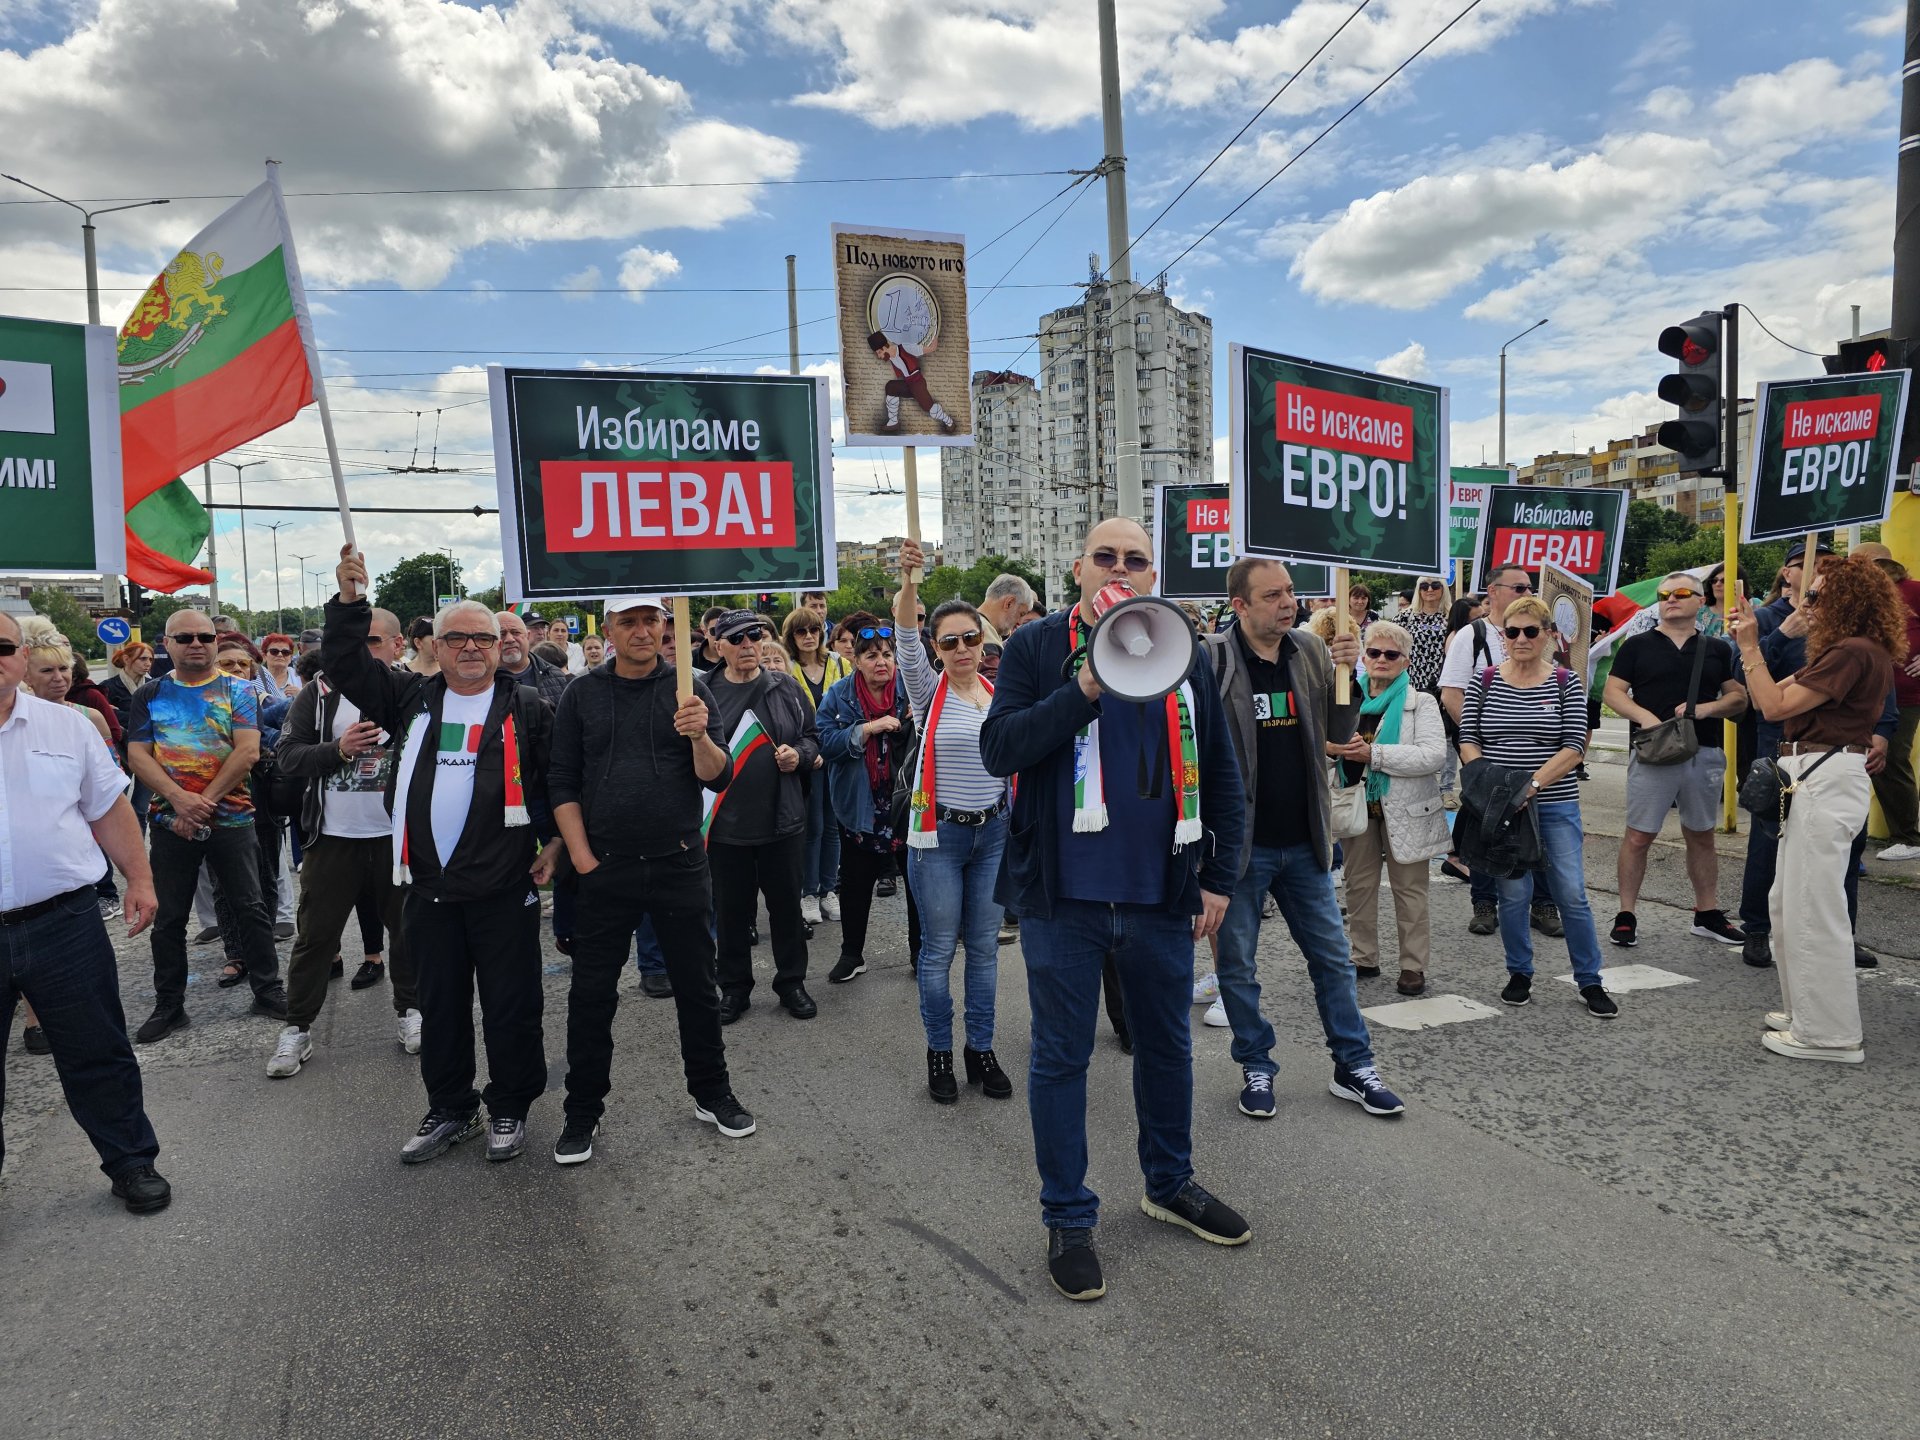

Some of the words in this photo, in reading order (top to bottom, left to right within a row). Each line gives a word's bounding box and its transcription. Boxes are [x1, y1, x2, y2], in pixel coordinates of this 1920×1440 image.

[845, 245, 880, 271] Под
[882, 253, 936, 271] новото
[939, 258, 964, 273] иго
[576, 405, 761, 459] Избираме
[1287, 393, 1316, 433] Не
[1322, 408, 1403, 449] искаме
[1791, 408, 1812, 438] Не
[1814, 408, 1873, 435] искаме
[1283, 443, 1407, 520] ЕВРО!
[1781, 440, 1871, 496] ЕВРО!
[572, 472, 774, 538] ЛЕВА!
[1196, 504, 1219, 526] Не
[1513, 502, 1594, 529] Избираме
[1503, 533, 1594, 568] ЛЕВА!
